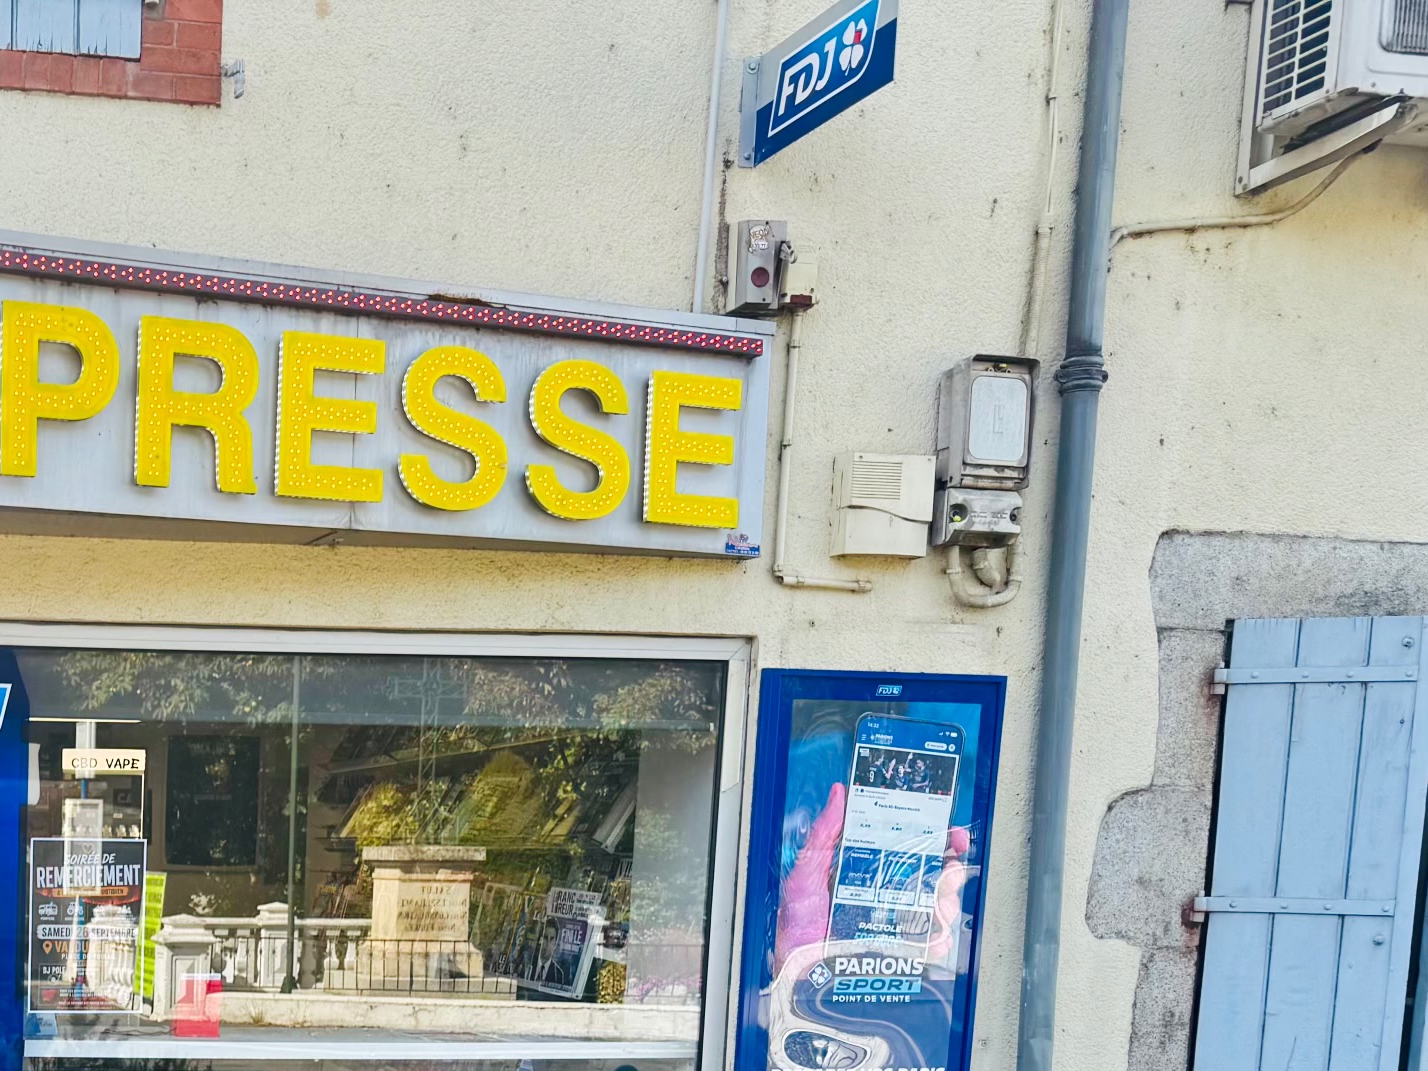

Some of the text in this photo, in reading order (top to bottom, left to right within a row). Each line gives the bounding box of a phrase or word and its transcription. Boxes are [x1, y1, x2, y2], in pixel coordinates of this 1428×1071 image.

[777, 37, 837, 117] FDJ
[878, 686, 892, 694] FDJ
[71, 757, 140, 769] CBD VAPE
[64, 852, 116, 865] SOIRÉE DE
[36, 865, 141, 889] REMERCIEMENT
[76, 927, 135, 938] 26 SEPTEMBRE
[858, 922, 903, 932] PACTOLE
[834, 957, 924, 975] PARIONS
[835, 978, 920, 991] SPORT
[880, 995, 911, 1003] VENTE
